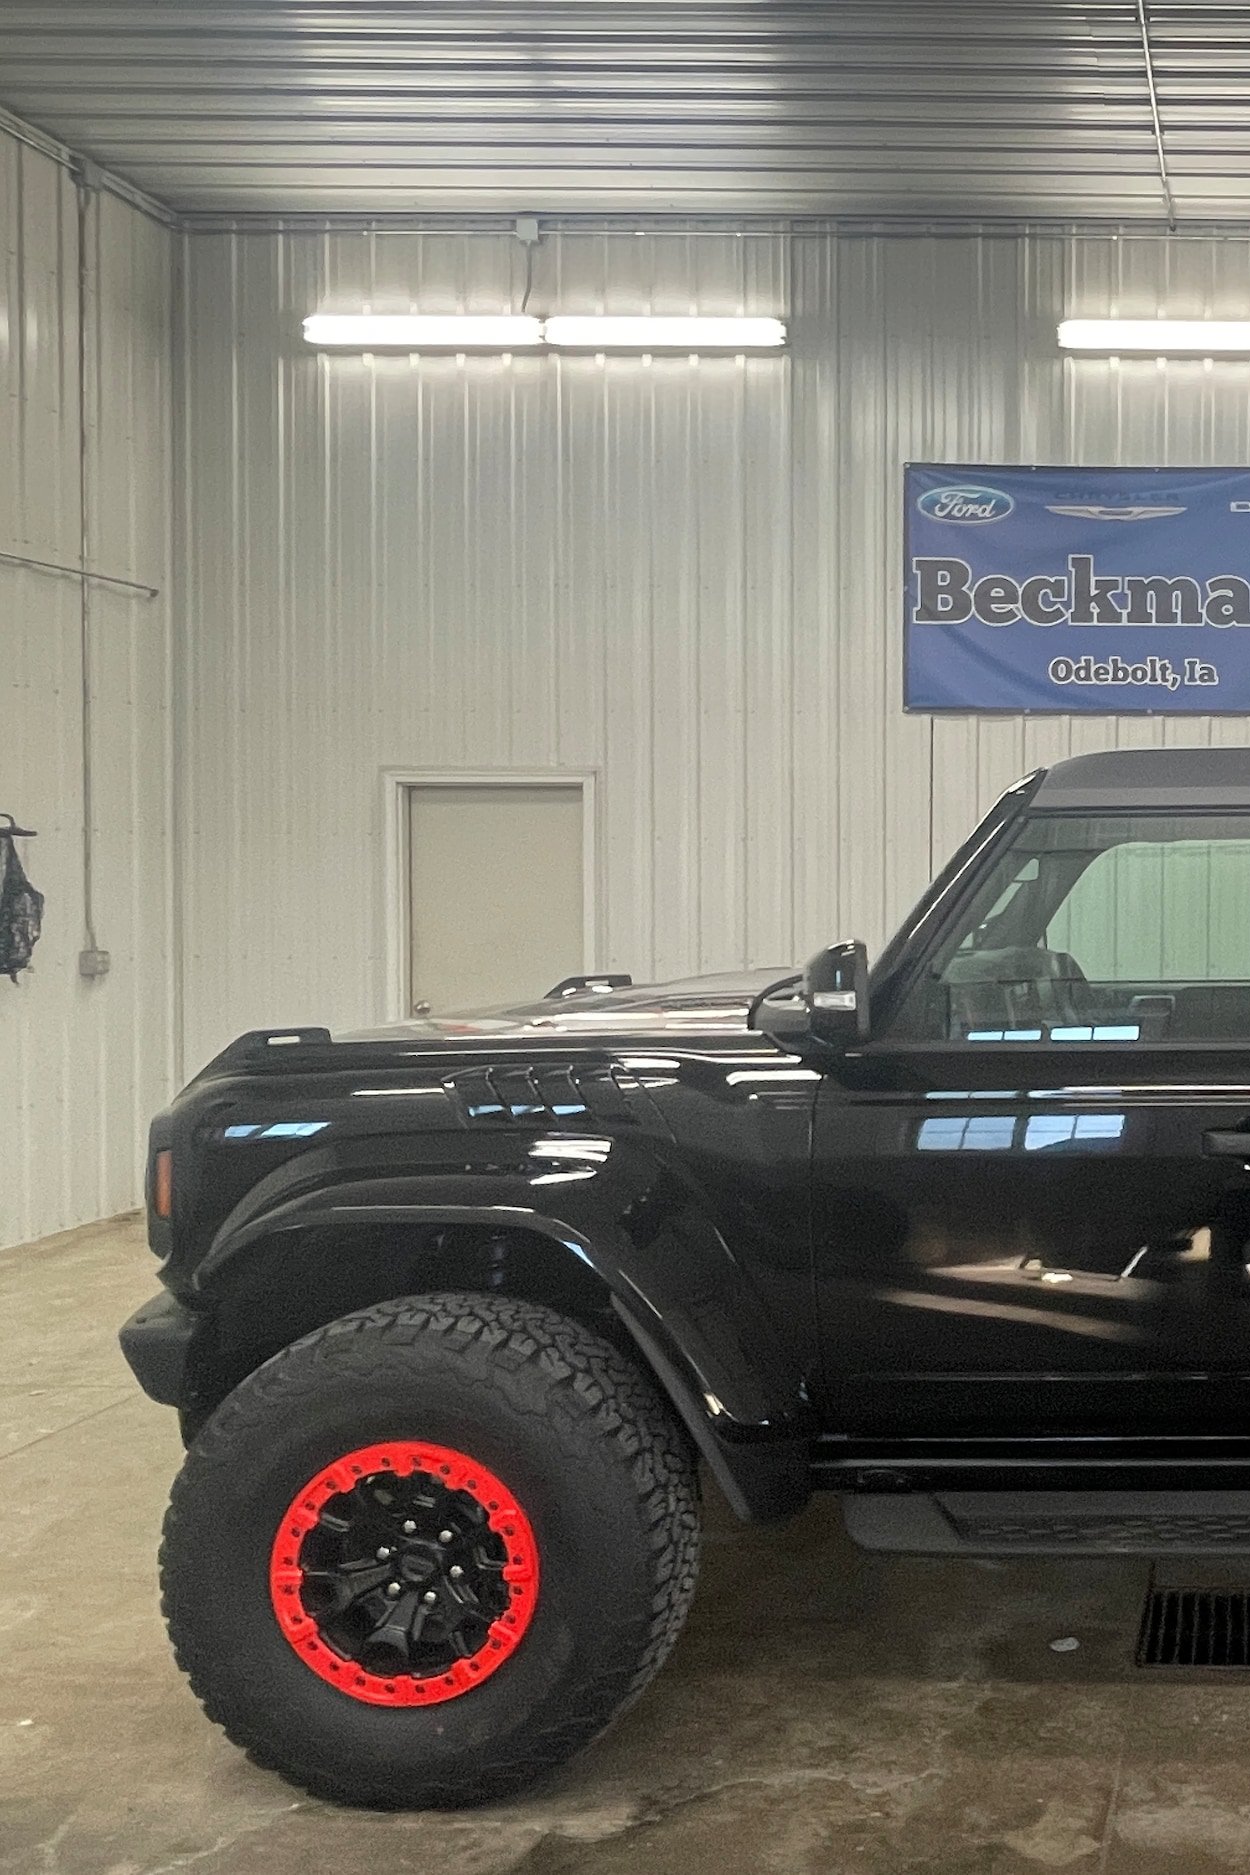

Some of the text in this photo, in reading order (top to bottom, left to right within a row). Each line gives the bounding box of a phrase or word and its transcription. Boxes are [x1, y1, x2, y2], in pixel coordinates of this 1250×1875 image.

[933, 491, 996, 519] Ford
[1048, 655, 1218, 691] Odebolt, Ia
